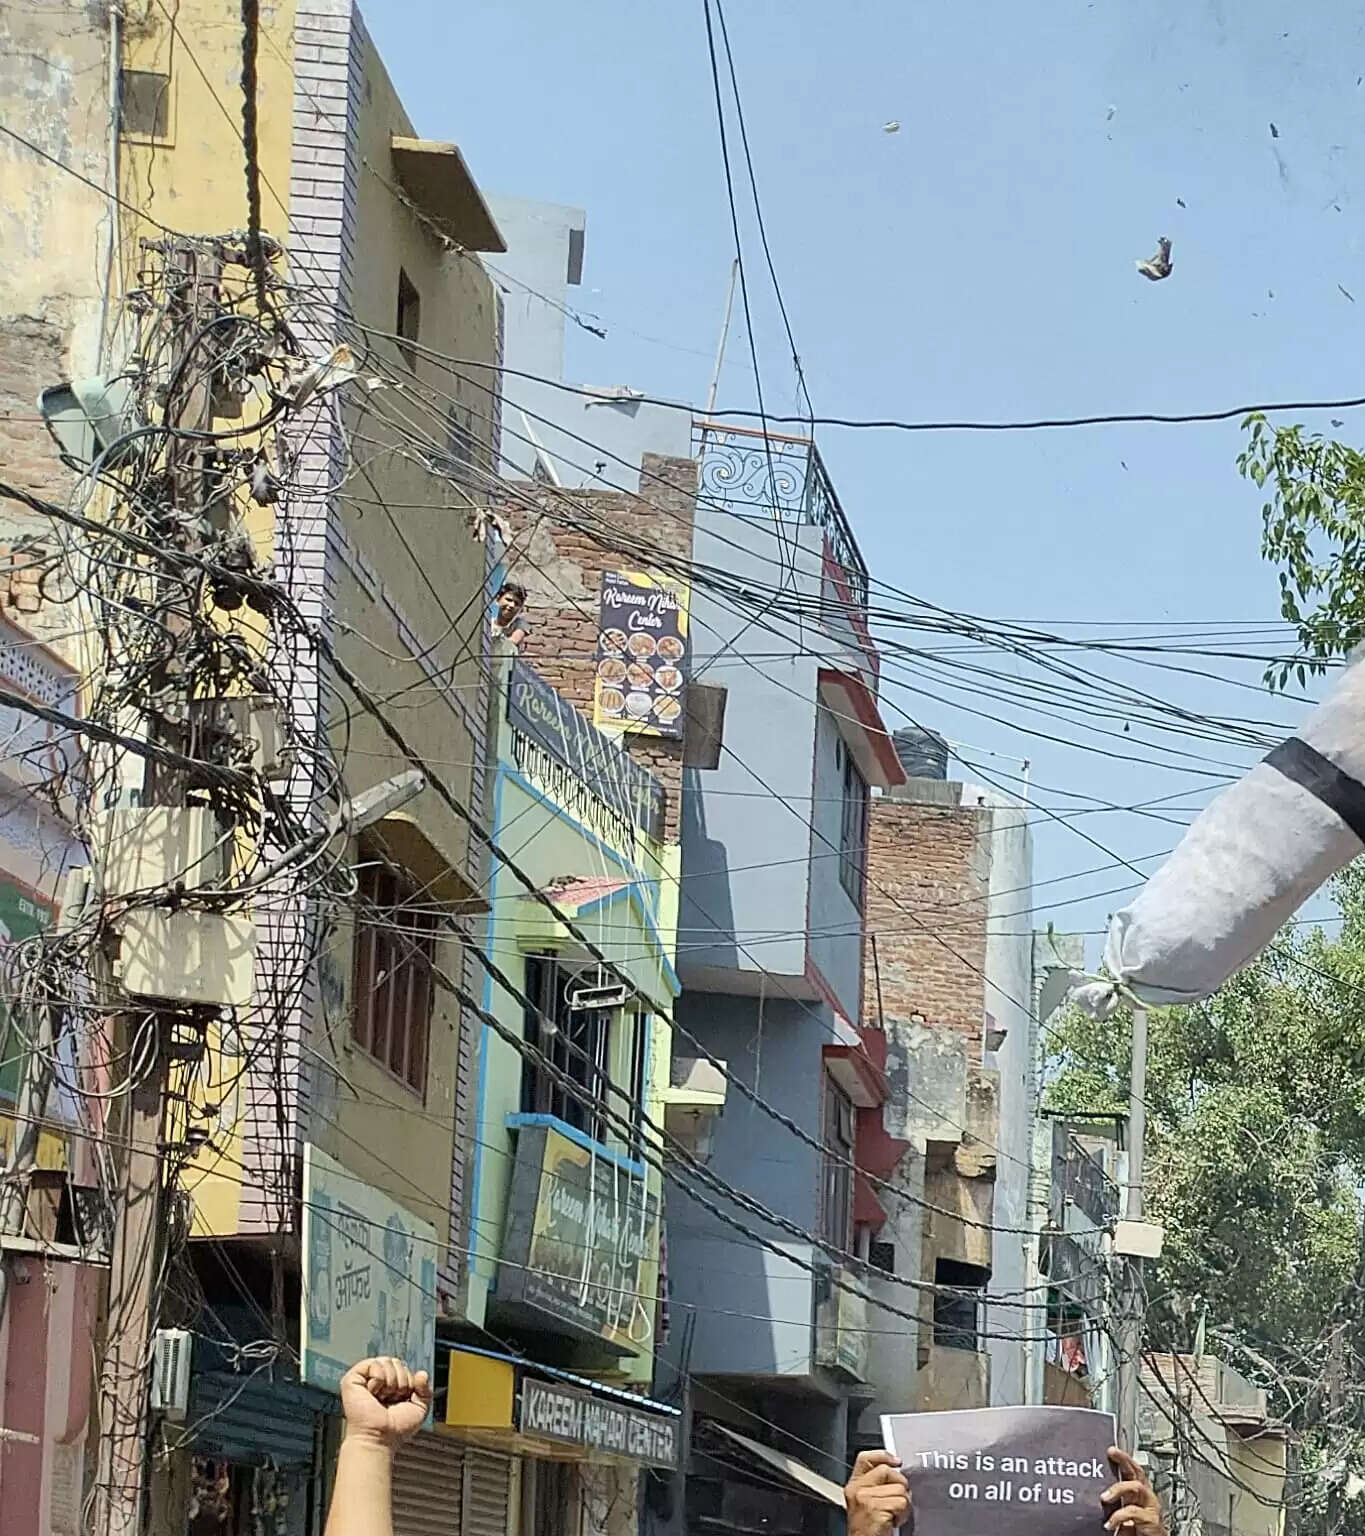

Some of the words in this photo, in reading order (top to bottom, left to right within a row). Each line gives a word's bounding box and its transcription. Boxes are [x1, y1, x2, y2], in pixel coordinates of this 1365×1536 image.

[628, 611, 662, 631] Center
[528, 1387, 583, 1440] KAREEM
[628, 1414, 674, 1461] CENTER
[916, 1451, 969, 1470] This
[975, 1451, 995, 1471] is
[1000, 1455, 1028, 1473] an
[1034, 1457, 1104, 1478] attack
[949, 1482, 978, 1498] on
[984, 1480, 1012, 1501] all
[1018, 1482, 1042, 1502] of
[1048, 1488, 1074, 1504] us
